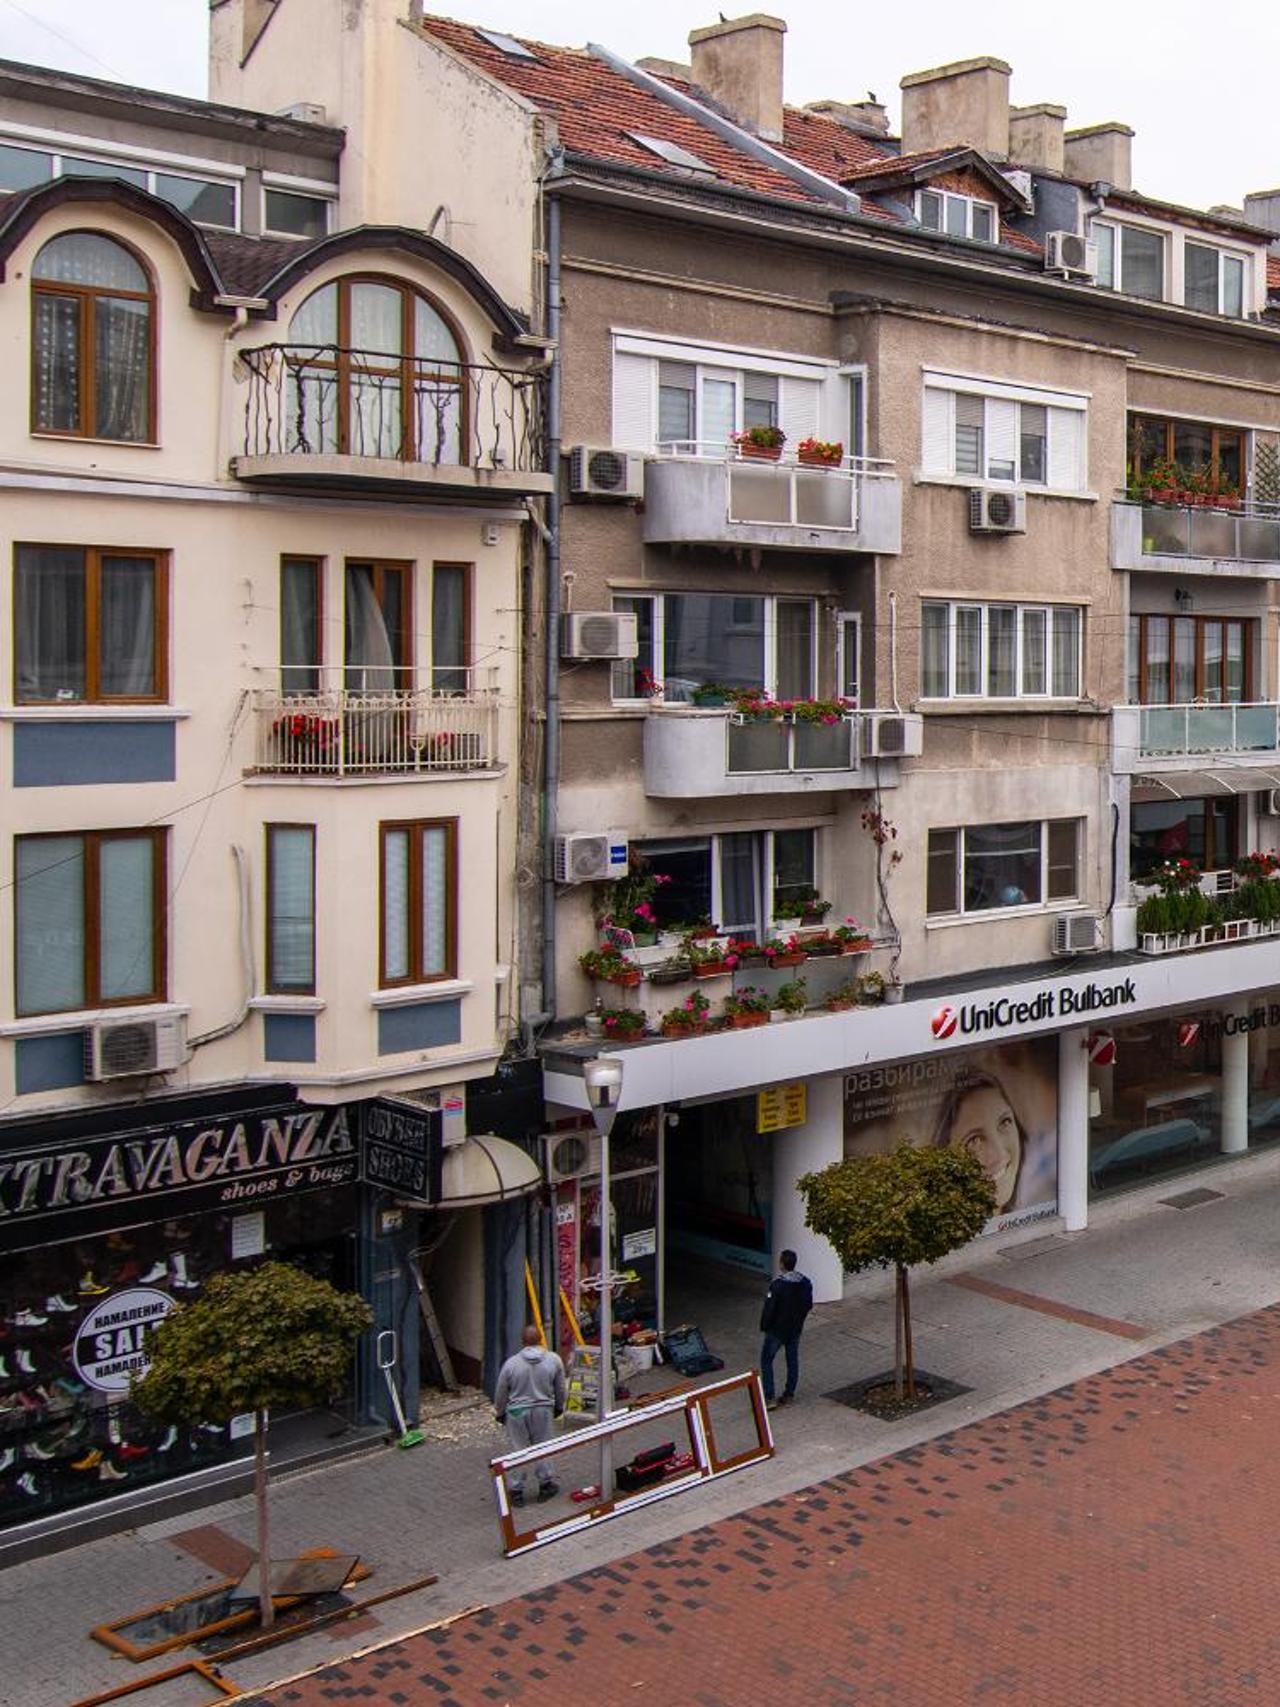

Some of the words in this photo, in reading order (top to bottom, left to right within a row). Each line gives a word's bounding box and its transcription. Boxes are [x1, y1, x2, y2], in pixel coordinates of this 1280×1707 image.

[960, 991, 1054, 1033] UniCredit
[1059, 978, 1136, 1015] Bulbank
[1200, 1006, 1266, 1040] UniCredit
[221, 1178, 278, 1201] shoes
[285, 1169, 303, 1188] &
[309, 1163, 354, 1183] bags
[95, 1302, 165, 1328] НАМАЛЕНИЕ
[95, 1321, 163, 1360] SAL
